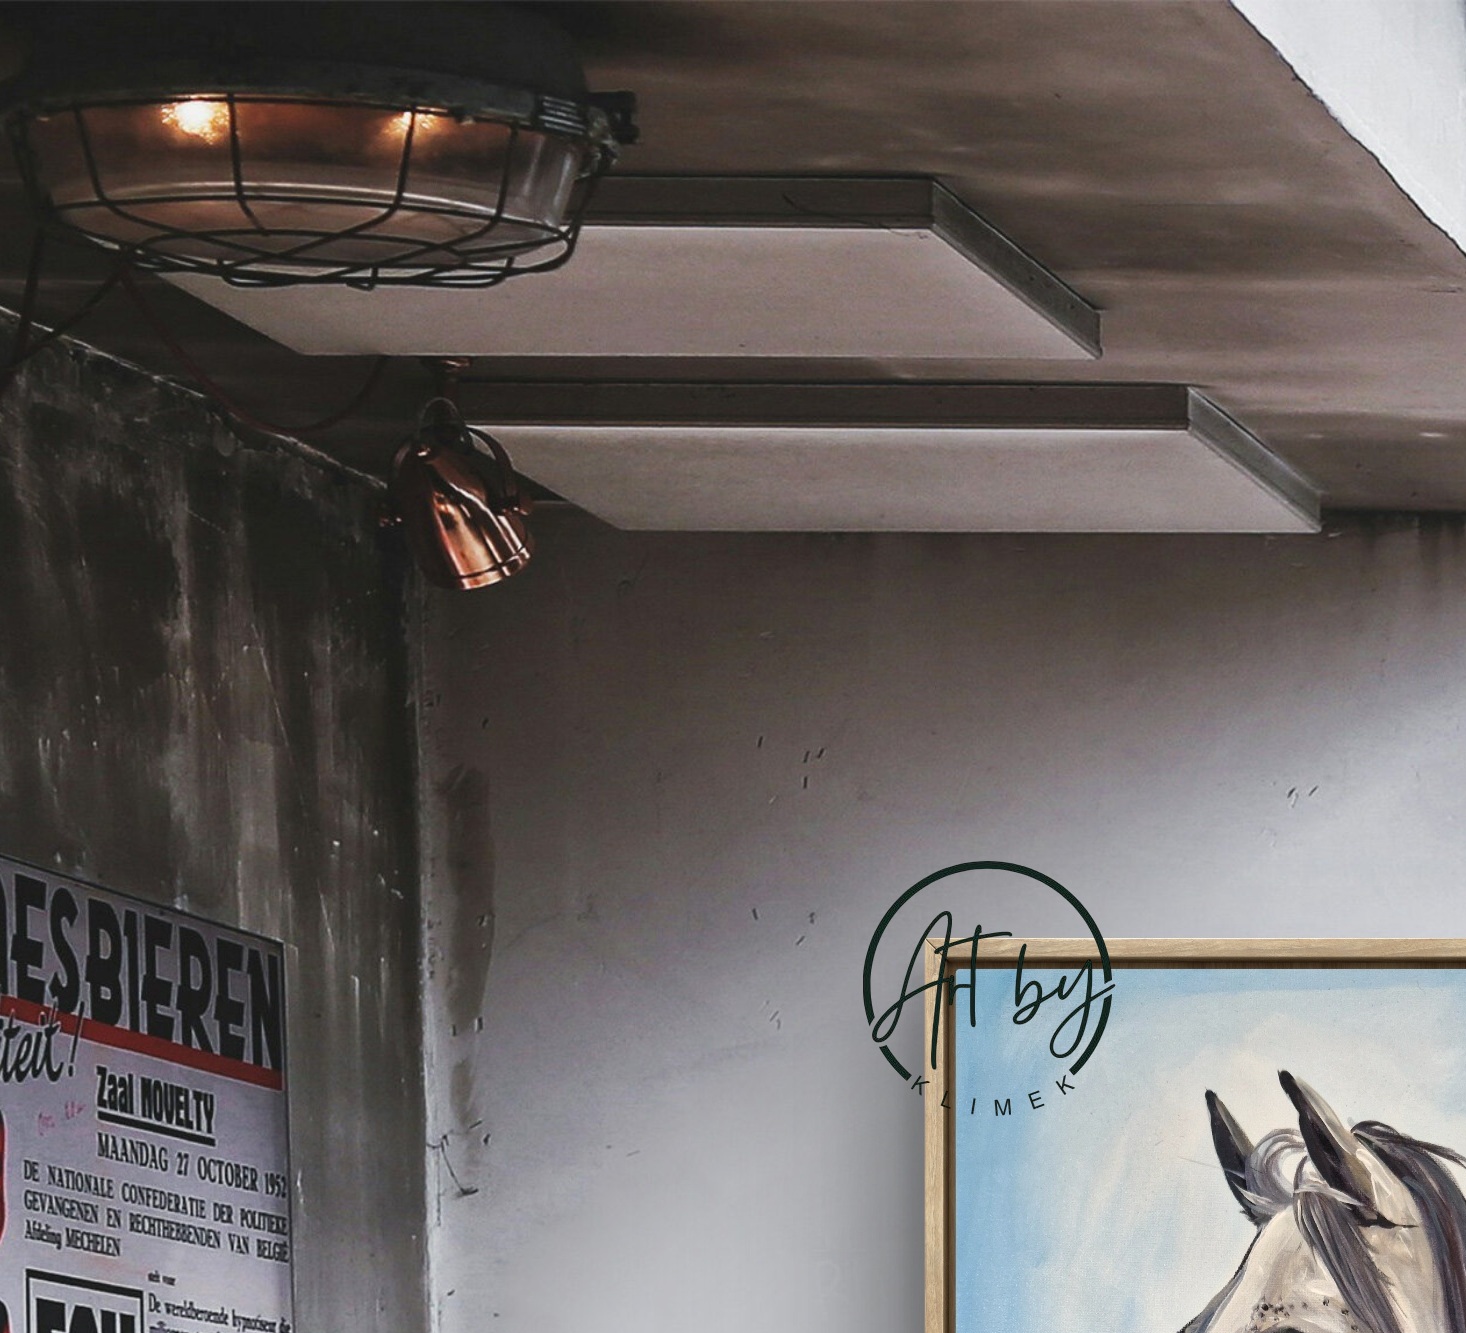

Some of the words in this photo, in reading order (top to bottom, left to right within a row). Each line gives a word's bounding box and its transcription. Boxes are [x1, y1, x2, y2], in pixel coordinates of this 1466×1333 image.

[0, 1000, 85, 1084] teit!
[96, 1066, 134, 1115] Zaal
[141, 1077, 215, 1134] NOVELTY
[23, 1160, 39, 1182] DE
[48, 1165, 114, 1199] NATIONALE
[121, 1183, 206, 1219] CONFEDERATIE
[213, 1202, 233, 1224] DER
[240, 1208, 287, 1236] POLITIEKE
[97, 1132, 168, 1172] MAANDAG
[176, 1152, 189, 1176] 27
[197, 1156, 258, 1192] OCTOBER
[264, 1172, 287, 1198] 1952
[24, 1190, 98, 1223] GEVANGENEN
[106, 1208, 121, 1228] EN
[228, 1233, 250, 1254] VAN
[65, 1227, 121, 1257] MECHELEN
[148, 1292, 161, 1313] De
